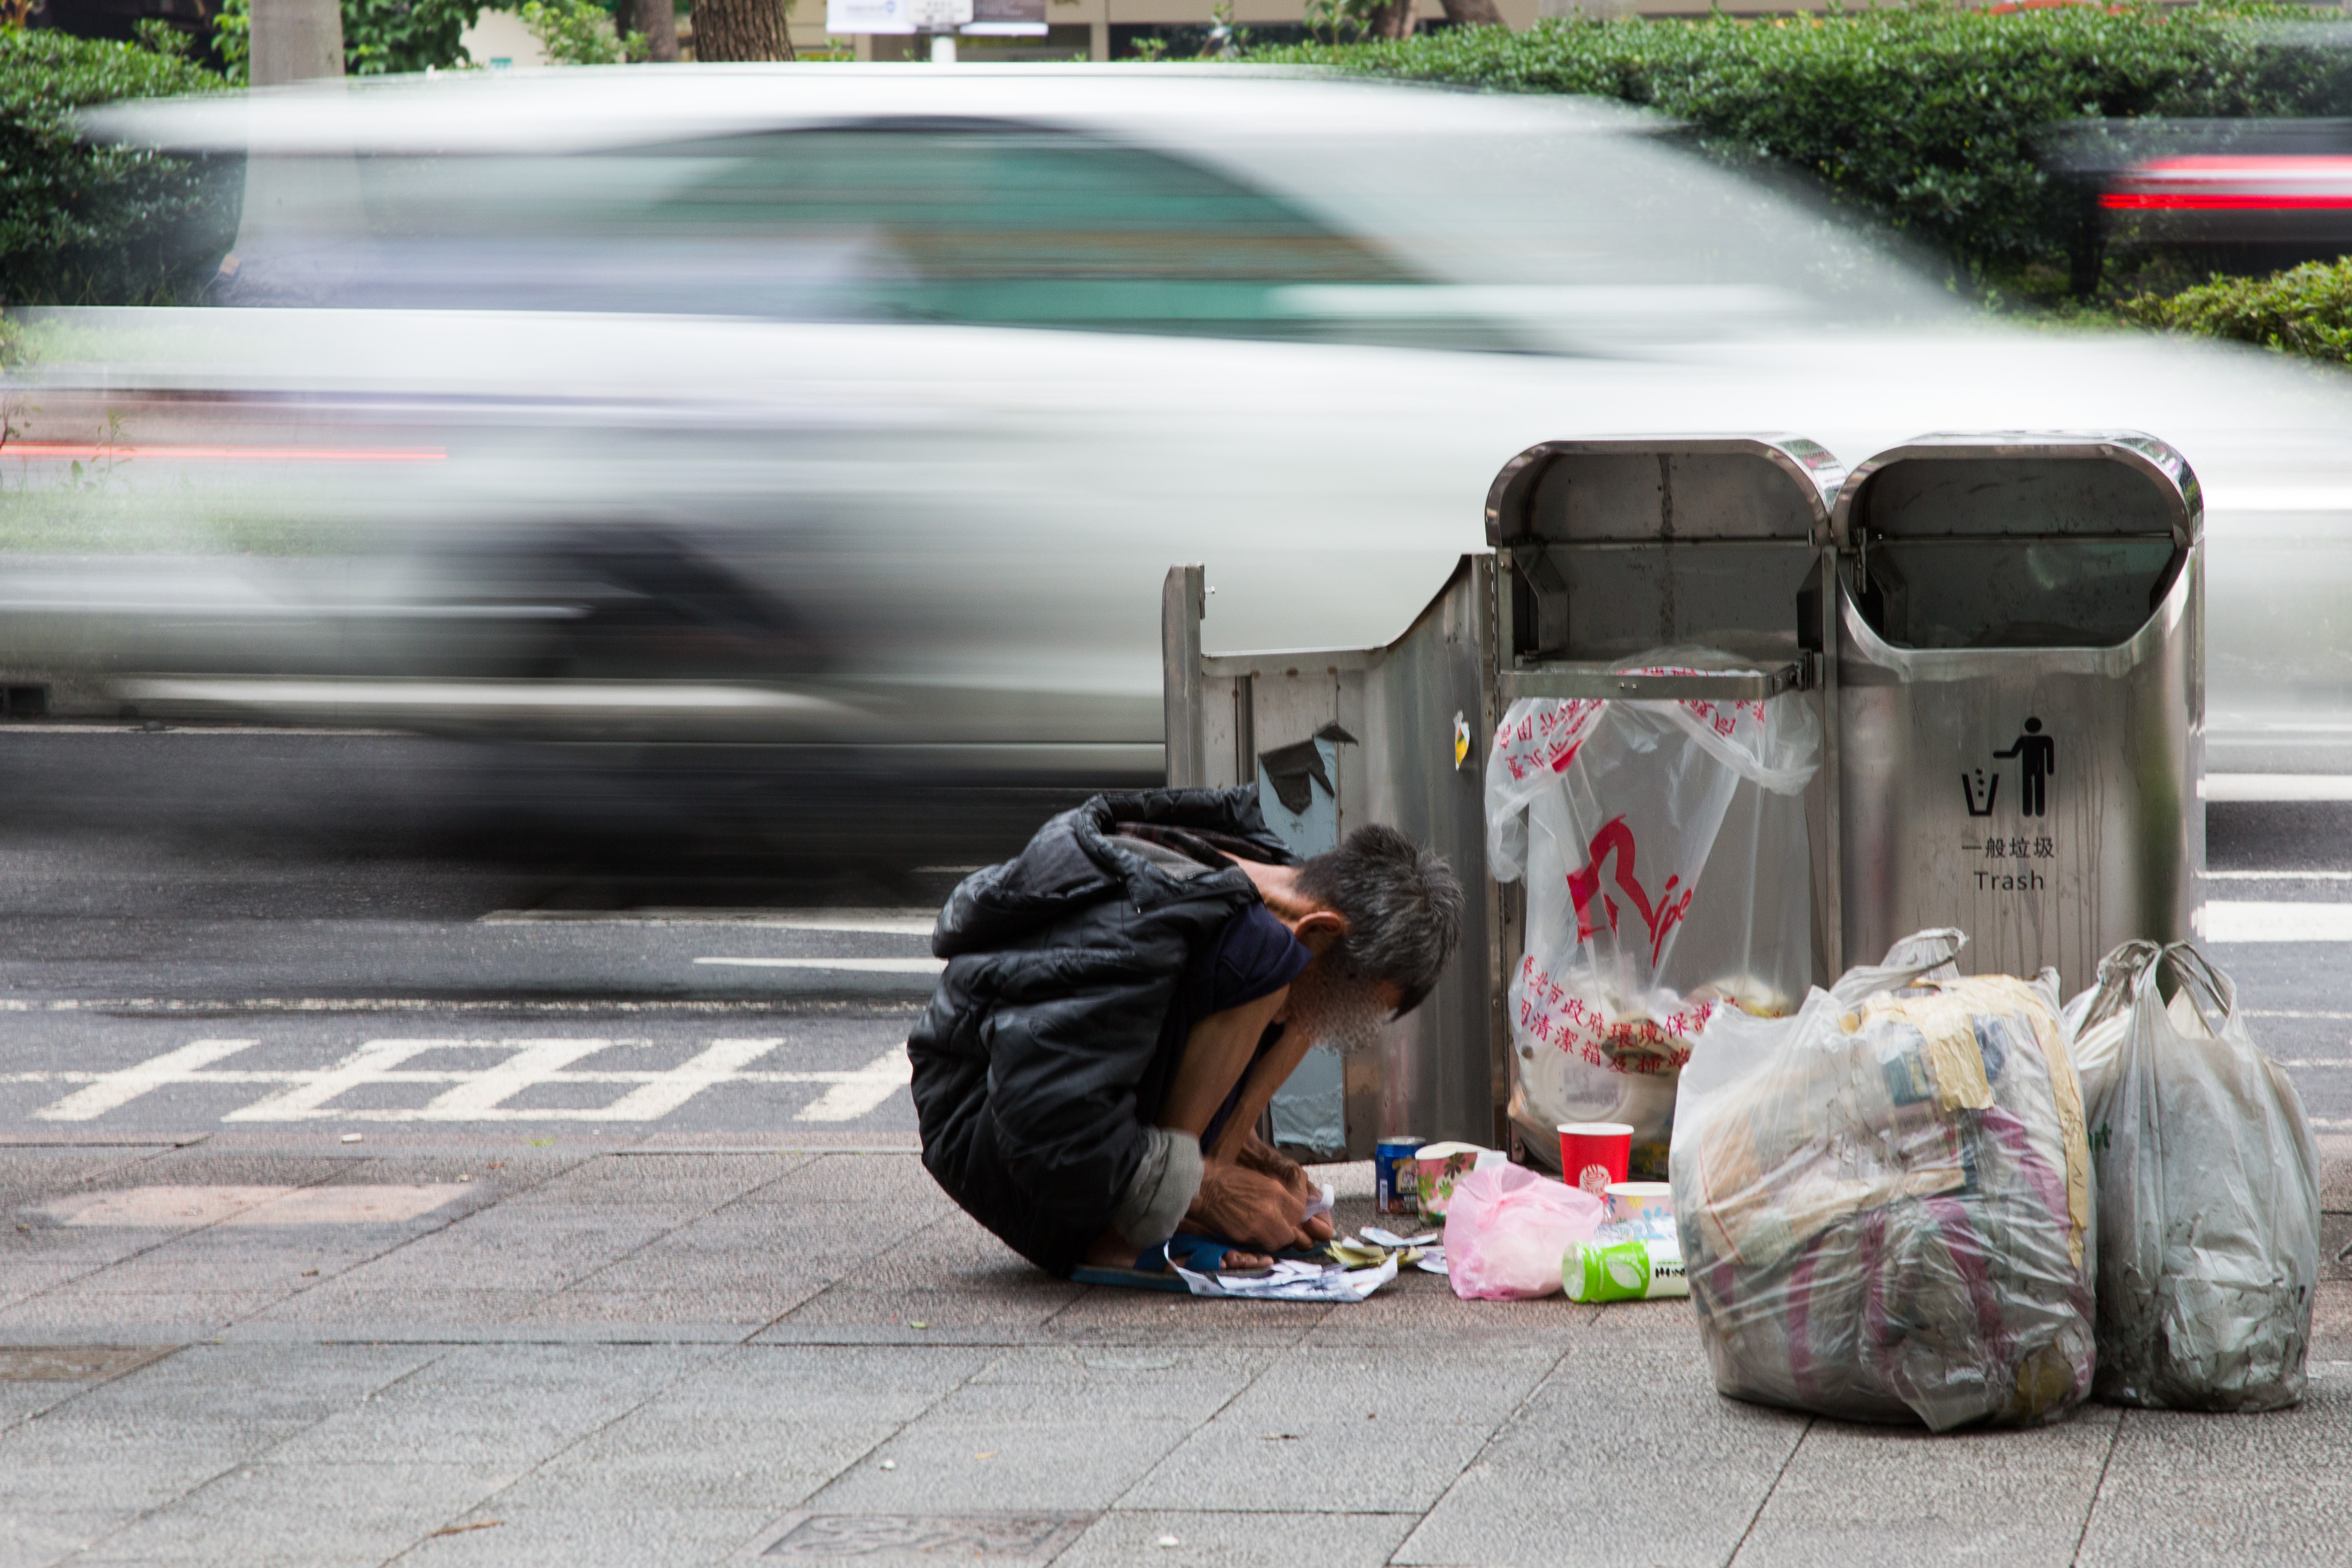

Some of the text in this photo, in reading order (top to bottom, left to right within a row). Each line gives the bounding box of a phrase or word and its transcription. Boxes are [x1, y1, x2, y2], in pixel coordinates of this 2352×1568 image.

[1962, 836, 2054, 859] 一般垃圾
[1974, 870, 2044, 890] Trash
